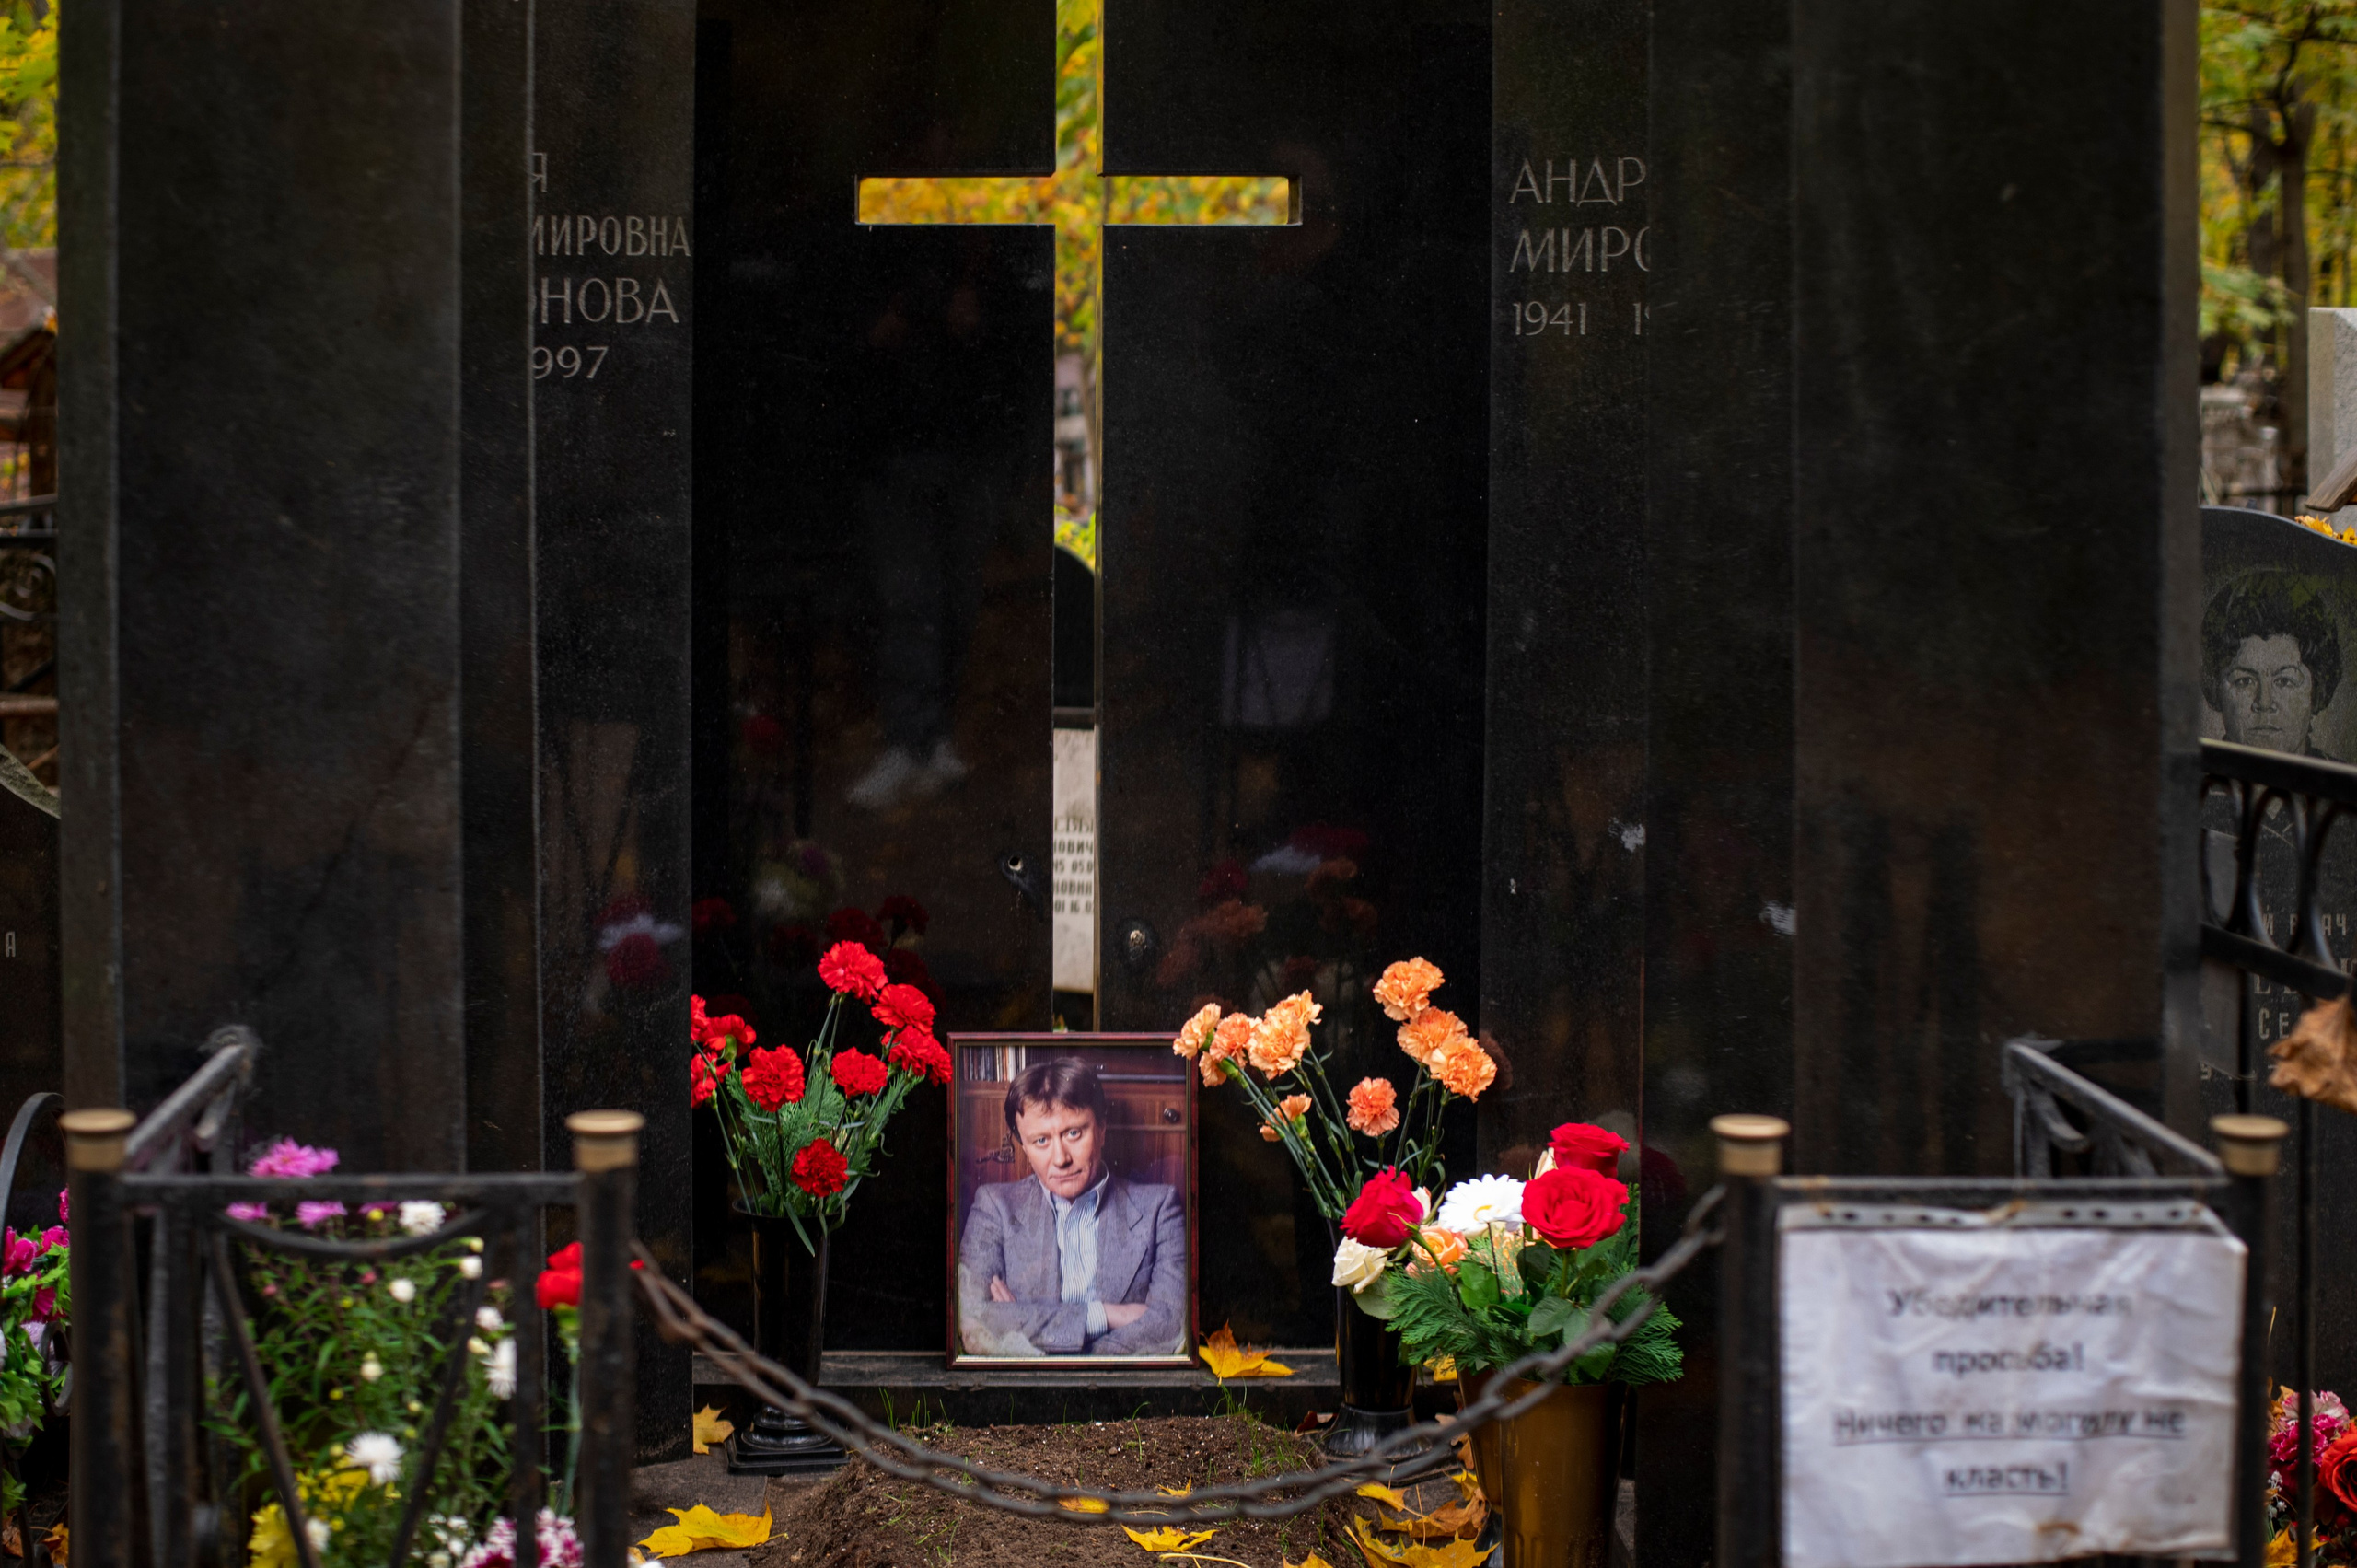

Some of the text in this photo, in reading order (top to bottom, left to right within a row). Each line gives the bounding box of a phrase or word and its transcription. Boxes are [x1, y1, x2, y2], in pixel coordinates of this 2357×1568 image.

[1509, 156, 1647, 208] АНДР
[532, 277, 679, 323] НОВА
[1513, 301, 1587, 336] 1941
[1054, 839, 1094, 855] ОВИЧ
